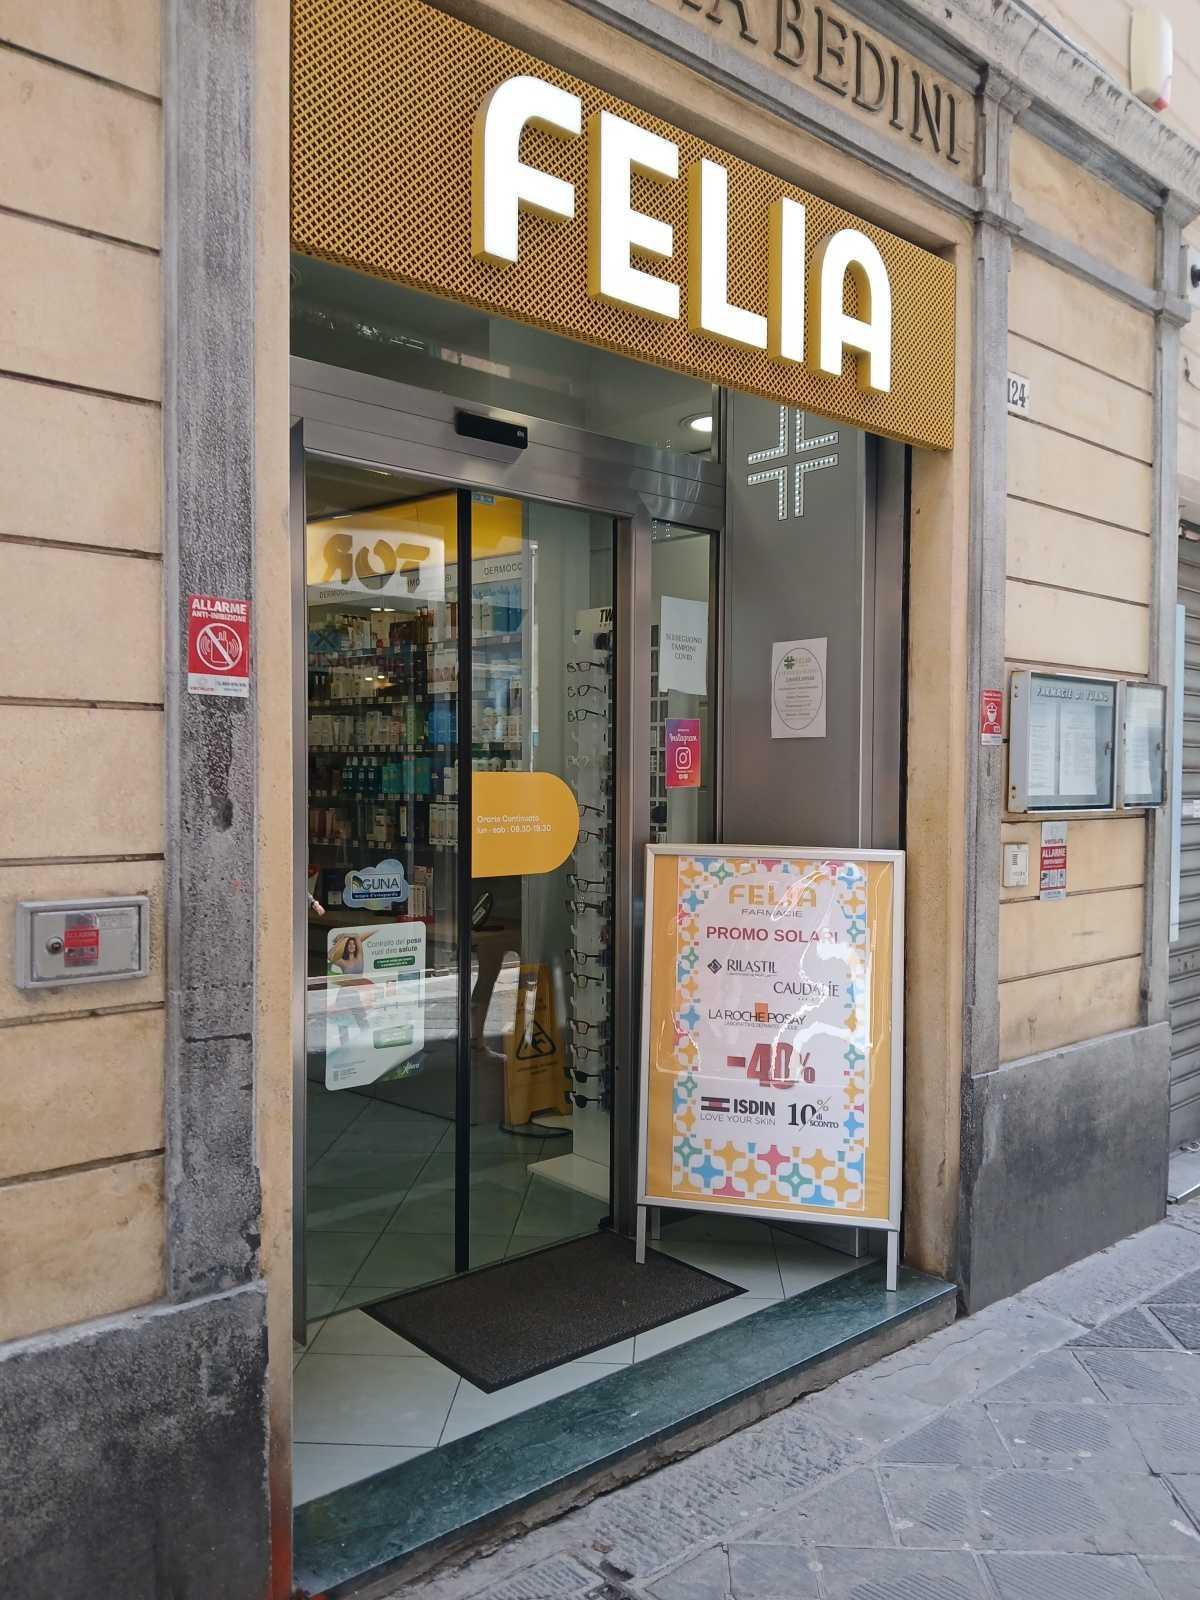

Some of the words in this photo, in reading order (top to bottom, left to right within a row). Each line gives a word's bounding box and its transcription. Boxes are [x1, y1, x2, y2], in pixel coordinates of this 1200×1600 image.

[774, 0, 961, 164] BEDINI
[472, 75, 892, 393] FELIA
[191, 599, 247, 615] ALLARME
[362, 877, 400, 890] GUNA
[706, 926, 769, 941] PROMO
[727, 959, 776, 974] RILASTIL
[708, 1009, 723, 1020] LA
[733, 1098, 776, 1116] ISDIN
[700, 1112, 725, 1122] LOVE
[726, 1114, 753, 1124] YOUR
[755, 1115, 776, 1126] SKIN
[808, 1120, 839, 1129] SCONTO
